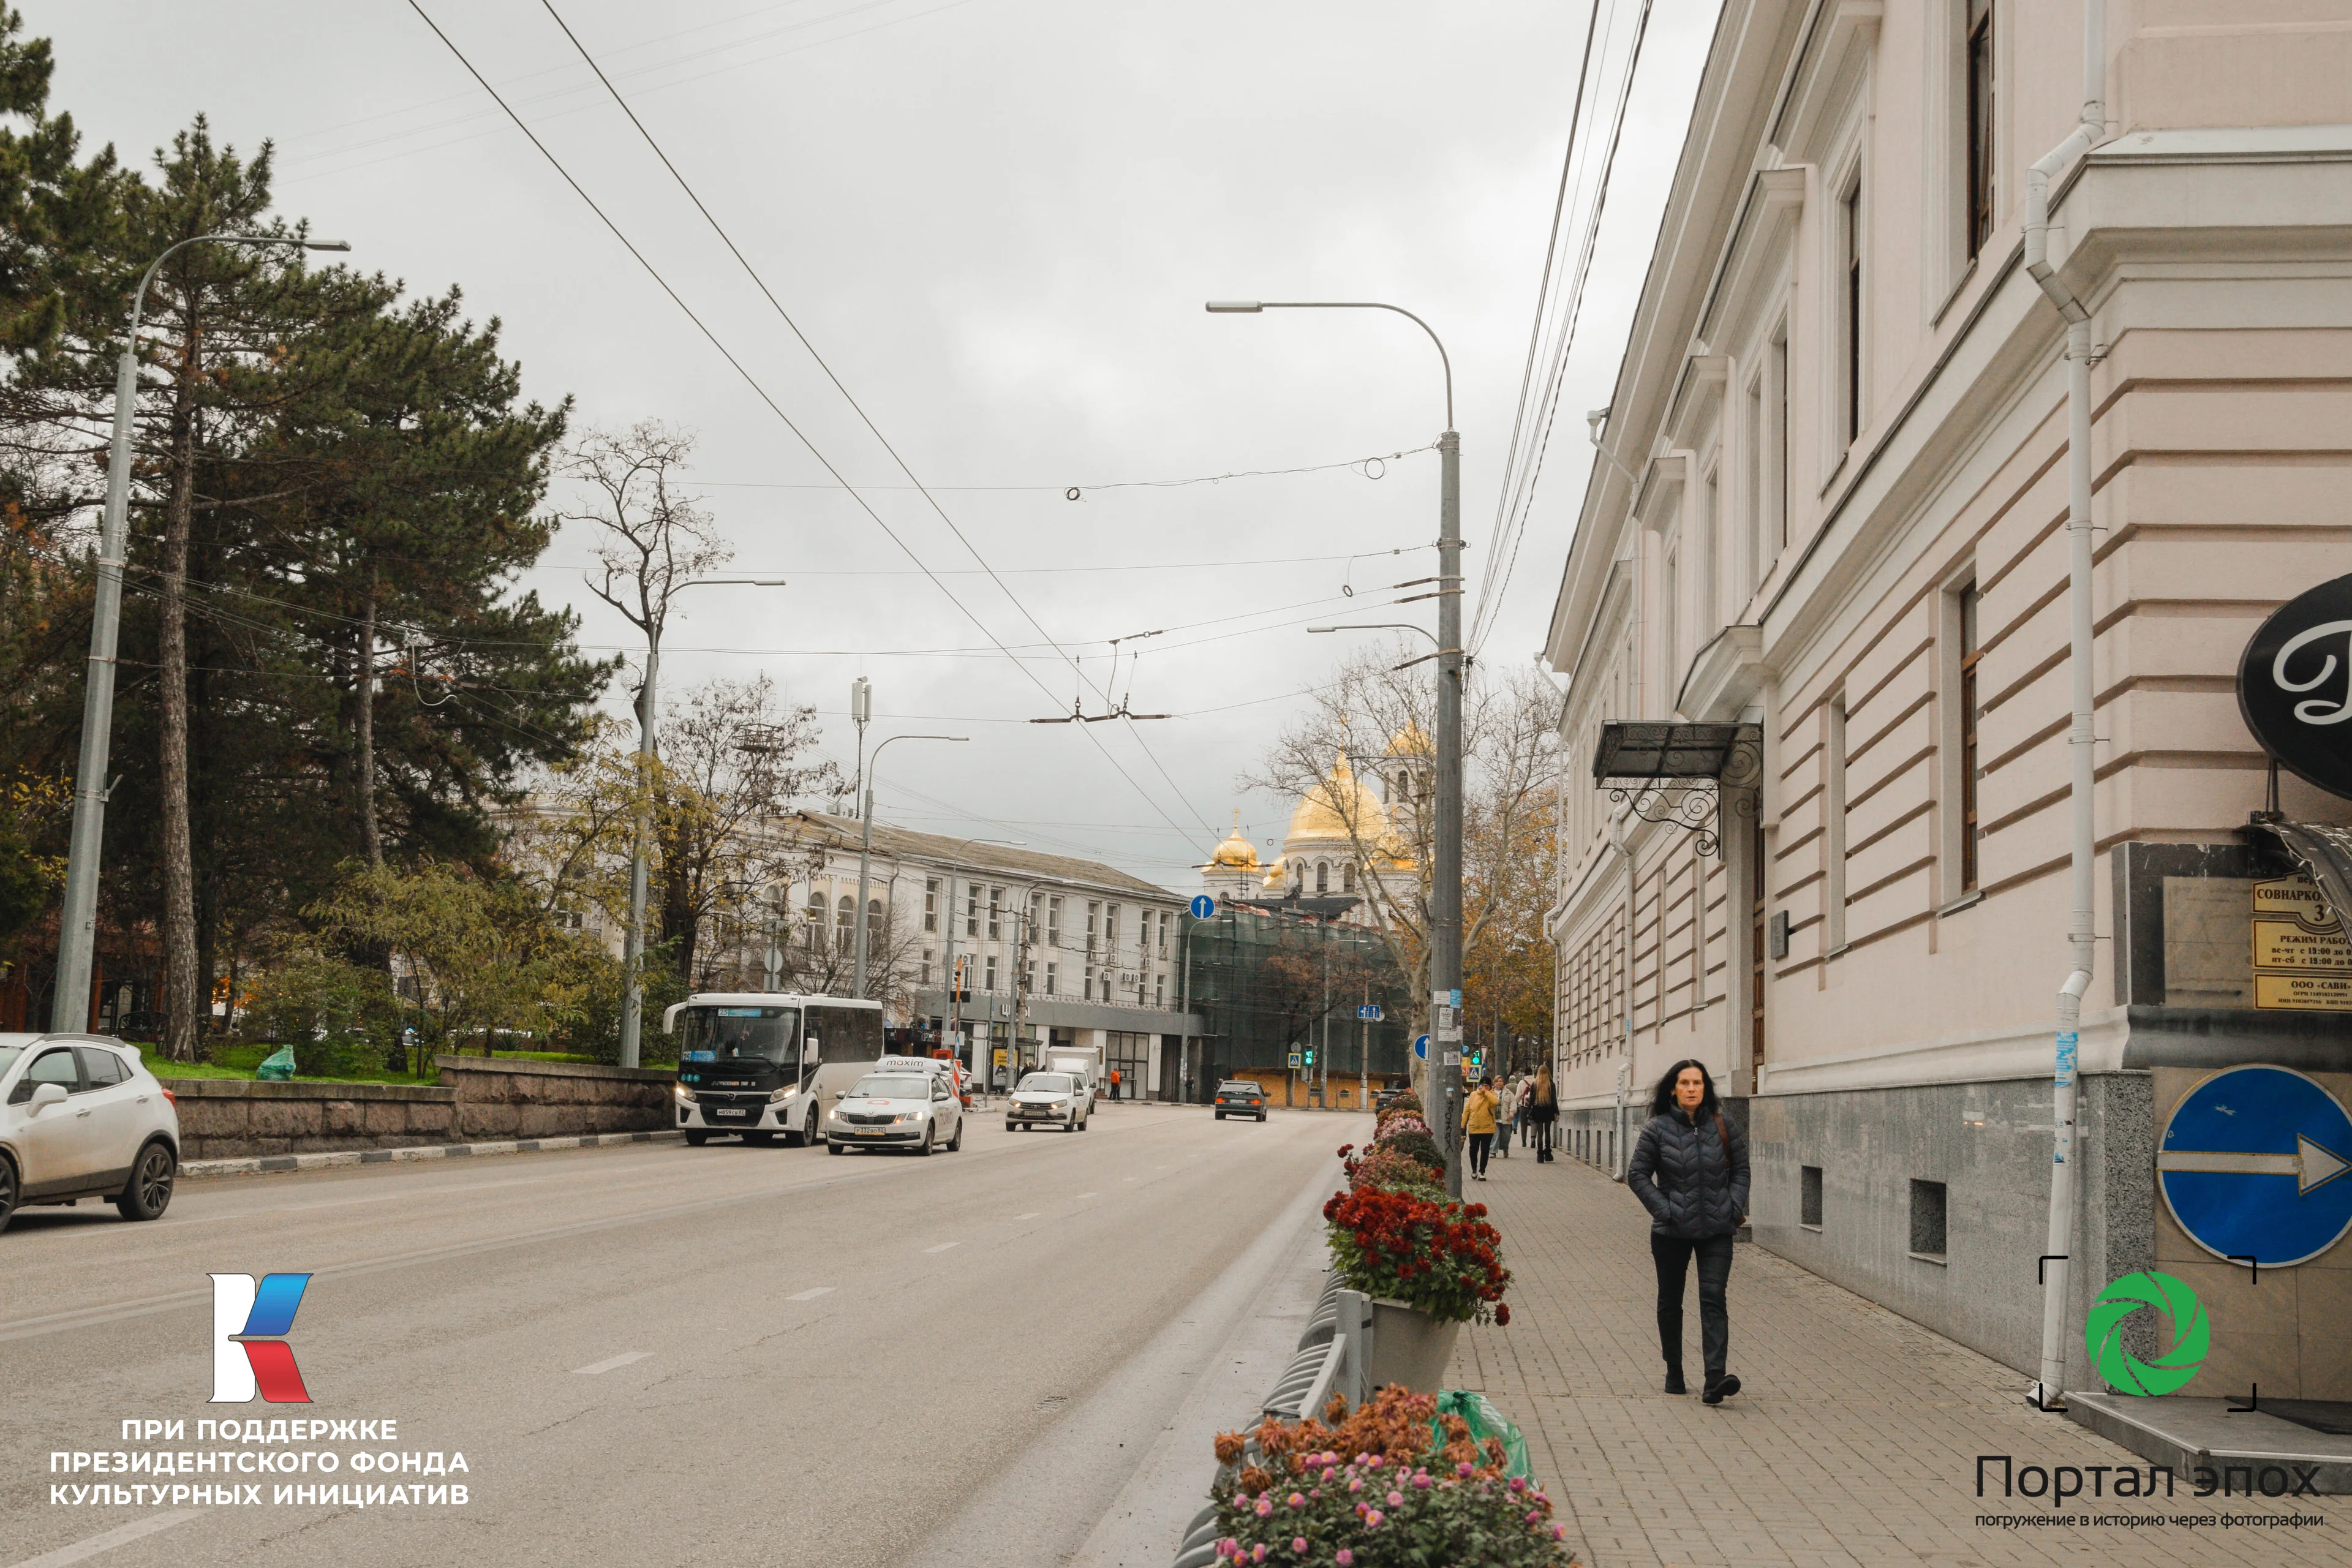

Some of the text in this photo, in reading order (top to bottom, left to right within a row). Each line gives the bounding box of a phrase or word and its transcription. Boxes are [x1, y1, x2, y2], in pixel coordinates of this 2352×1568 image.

[2314, 904, 2324, 922] 3
[2280, 935, 2316, 944] РЕЖИМ
[684, 1053, 690, 1061] 25
